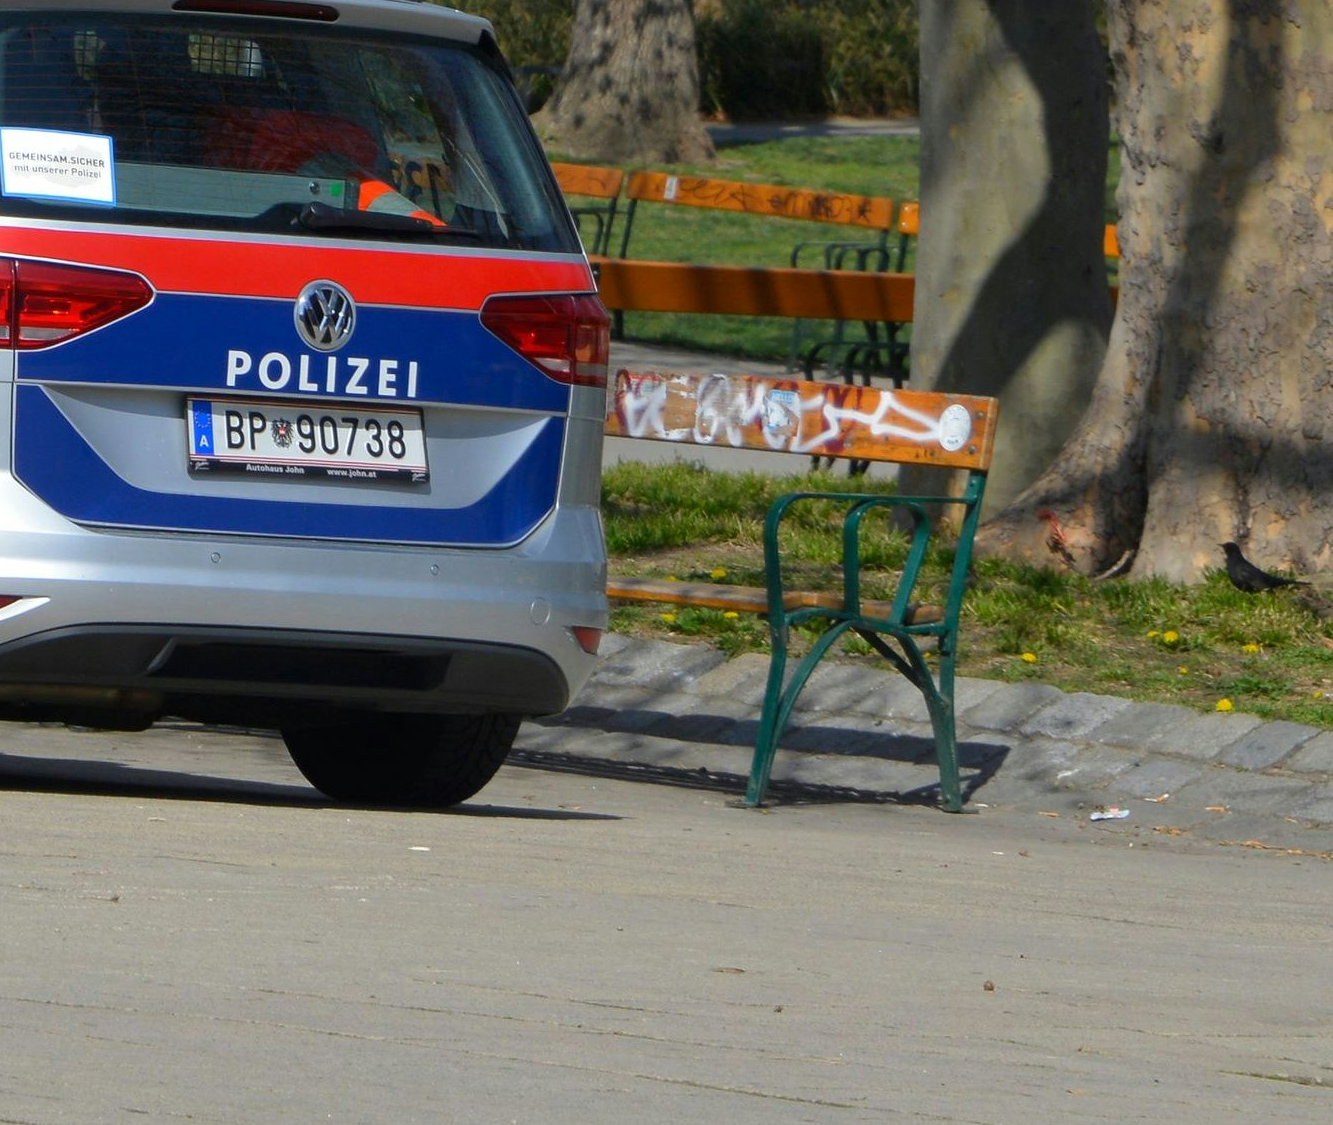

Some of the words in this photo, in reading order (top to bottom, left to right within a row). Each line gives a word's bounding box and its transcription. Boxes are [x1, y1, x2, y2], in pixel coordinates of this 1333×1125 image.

[9, 152, 105, 168] GEMEINSAM.SICHER
[32, 166, 69, 175] unserer
[71, 168, 102, 179] Polizei
[226, 349, 418, 398] POLIZEI
[199, 434, 210, 448] A
[225, 410, 267, 451] BP
[296, 413, 406, 459] 90738
[246, 463, 284, 473] Autohaus
[285, 465, 305, 475] John
[326, 468, 377, 479] www.john.at
